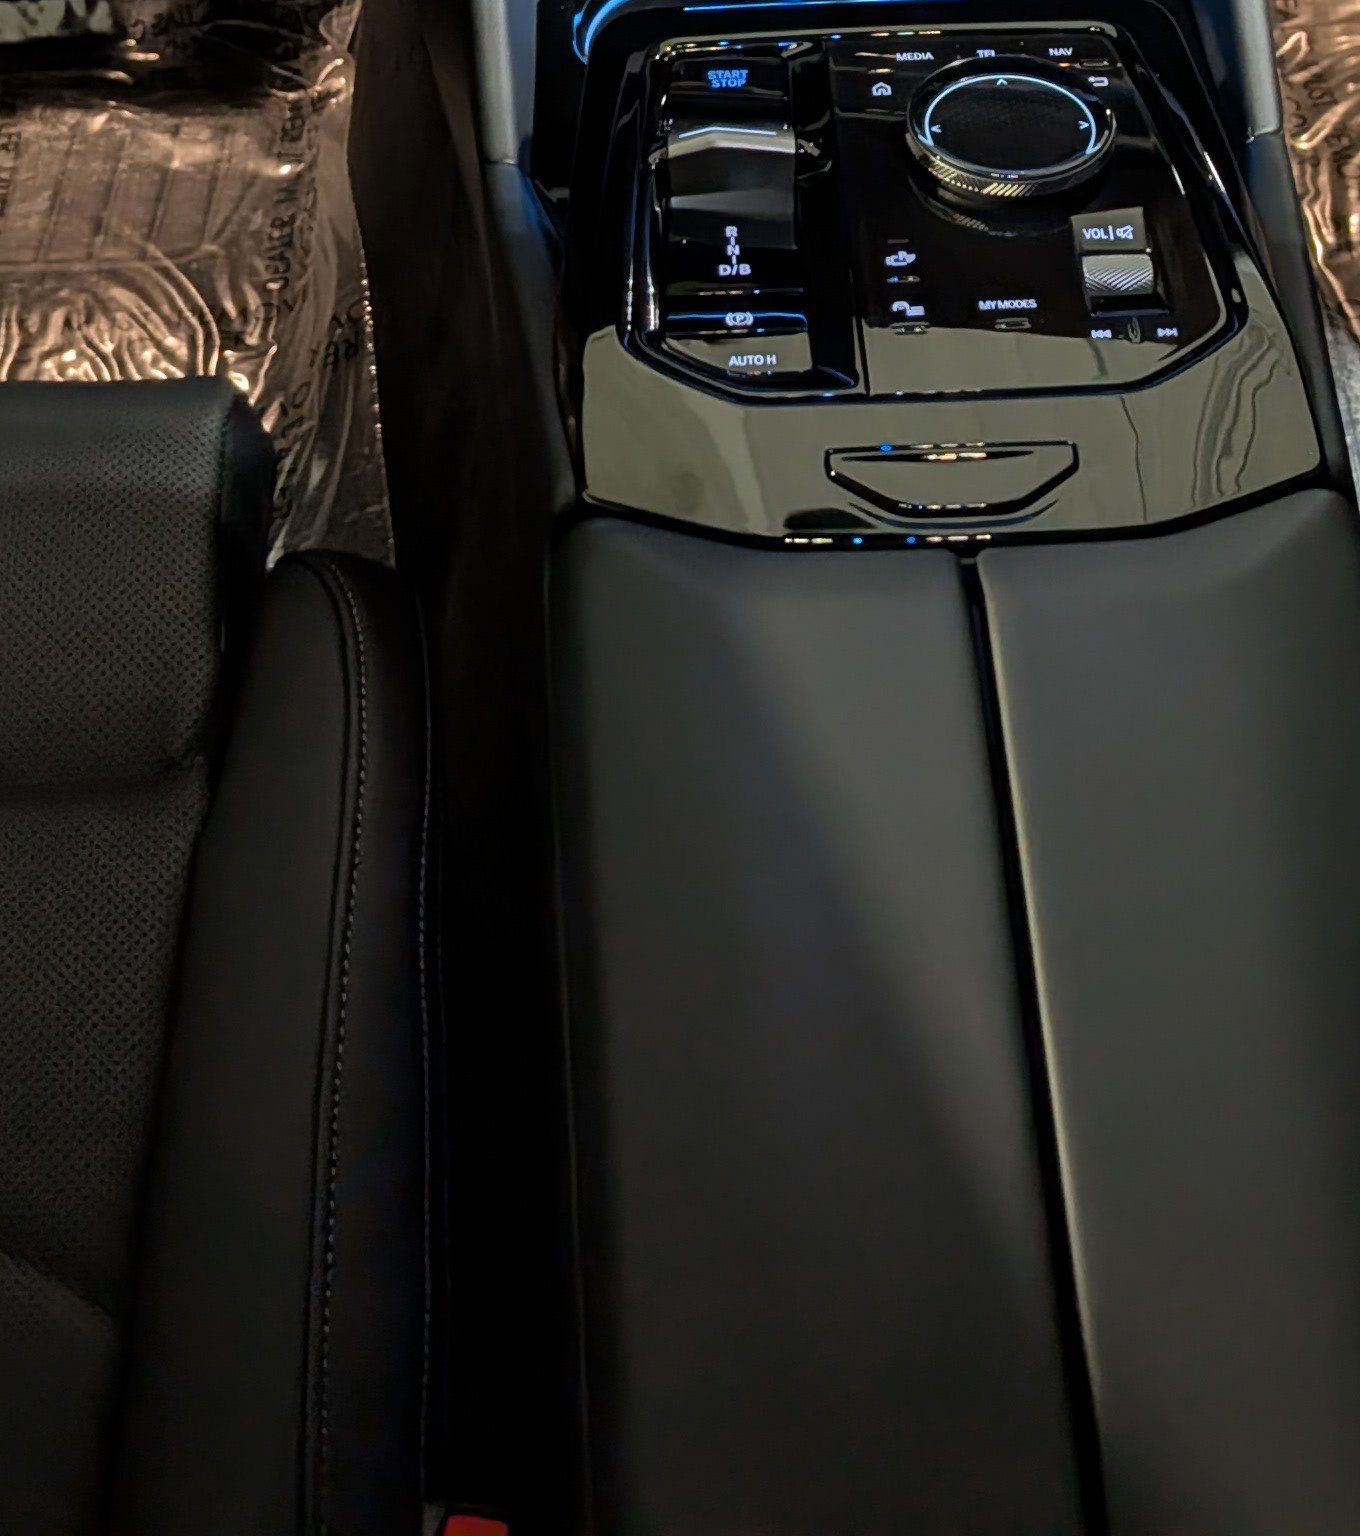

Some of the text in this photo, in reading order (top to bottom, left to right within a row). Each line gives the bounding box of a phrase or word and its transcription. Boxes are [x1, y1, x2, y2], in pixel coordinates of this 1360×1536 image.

[896, 50, 935, 62] MEDIA
[1048, 46, 1074, 57] NAV
[707, 68, 750, 79] START
[710, 78, 747, 89] STOP
[1081, 225, 1108, 240] VOL
[726, 244, 741, 256] N
[718, 263, 753, 277] D/B
[998, 297, 1038, 311] MODES
[728, 353, 778, 367] AUTO H
